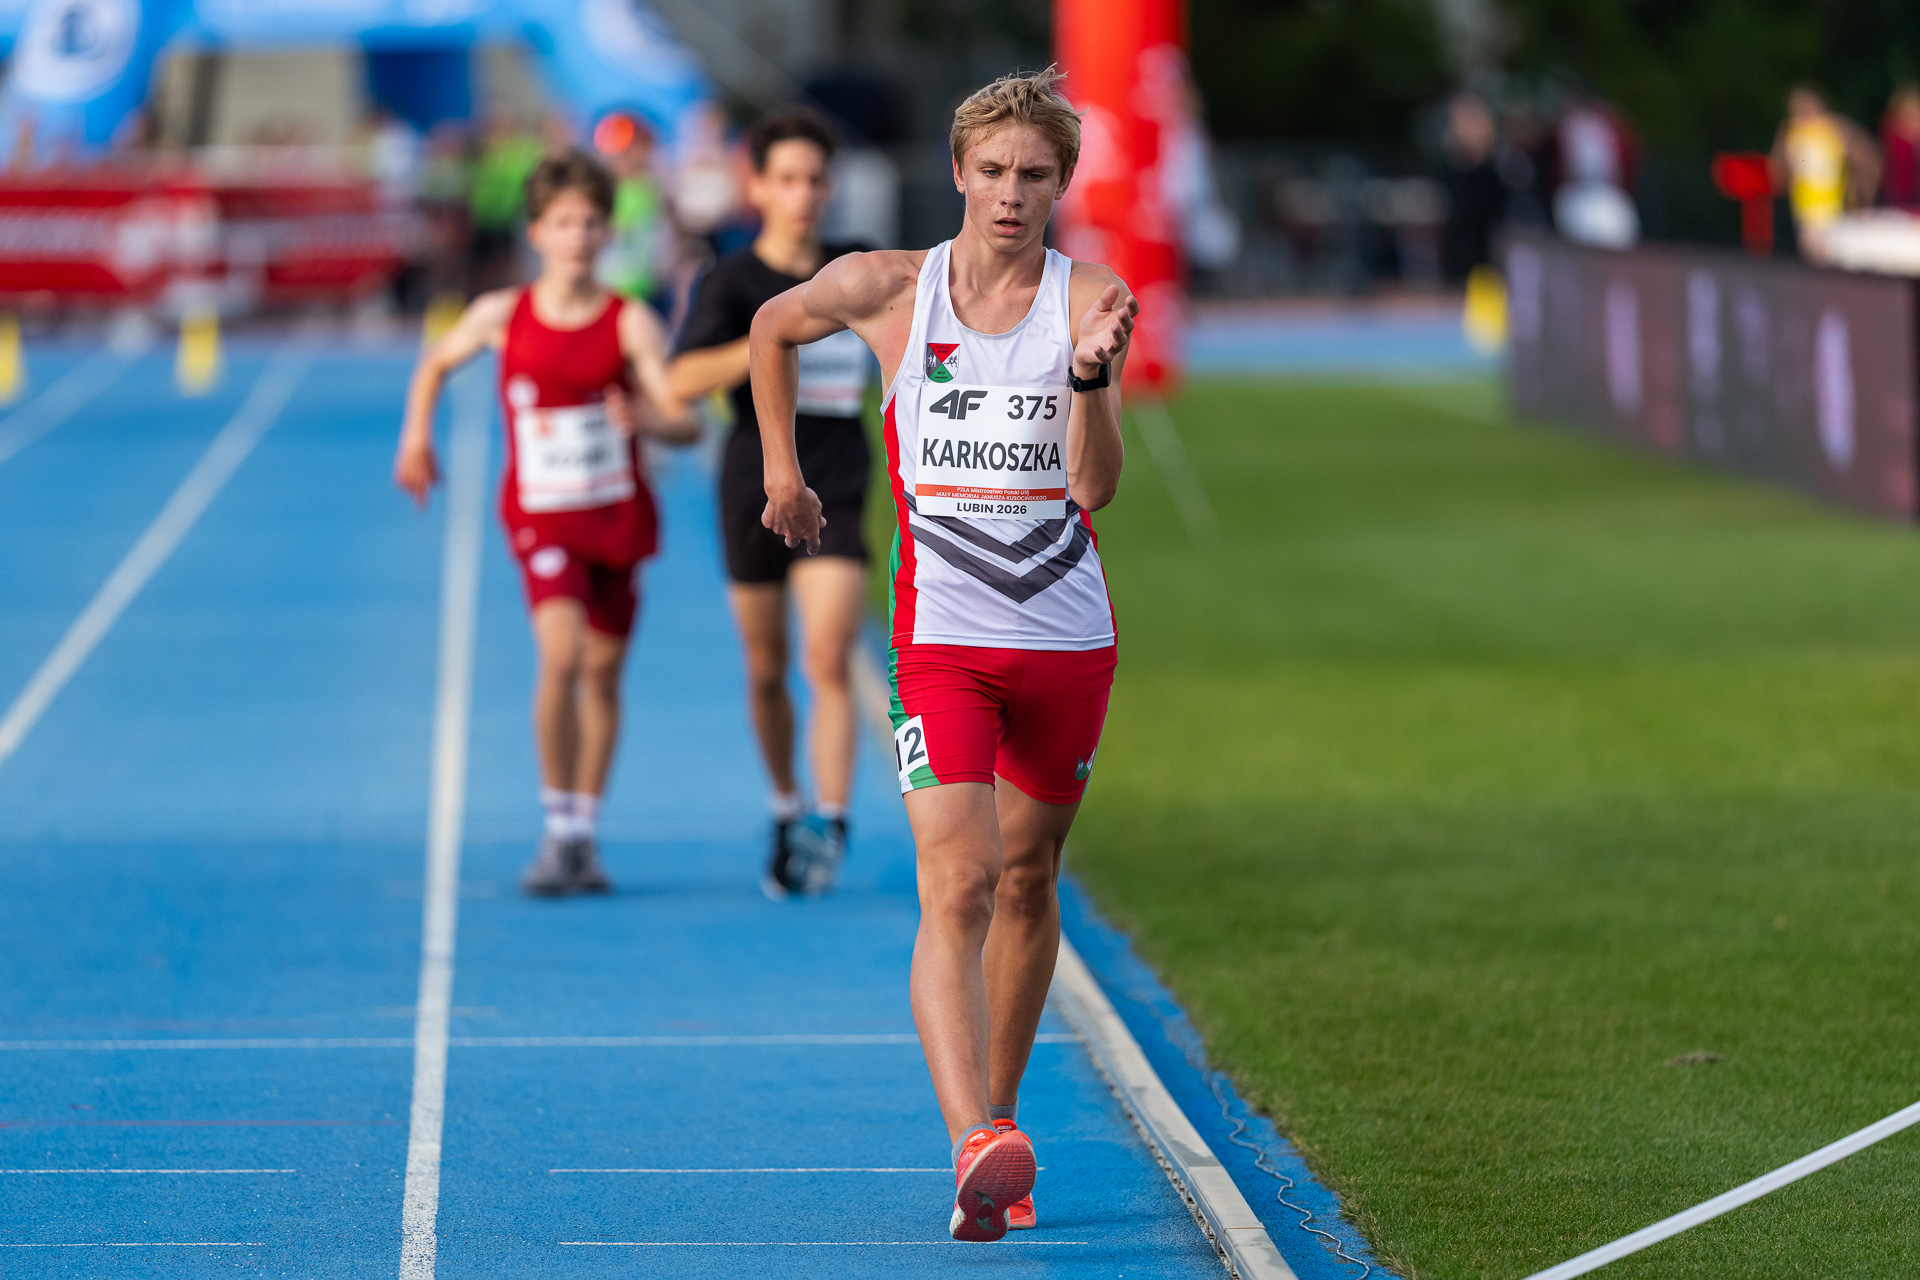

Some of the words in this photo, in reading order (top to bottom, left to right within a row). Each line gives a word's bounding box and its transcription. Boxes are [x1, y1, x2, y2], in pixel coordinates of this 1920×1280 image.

[929, 389, 988, 420] 4F
[1007, 395, 1058, 420] 375
[922, 438, 1062, 472] KARKOSZKA
[957, 502, 994, 514] LUBIN
[997, 504, 1027, 514] 2026
[895, 726, 926, 773] 12
